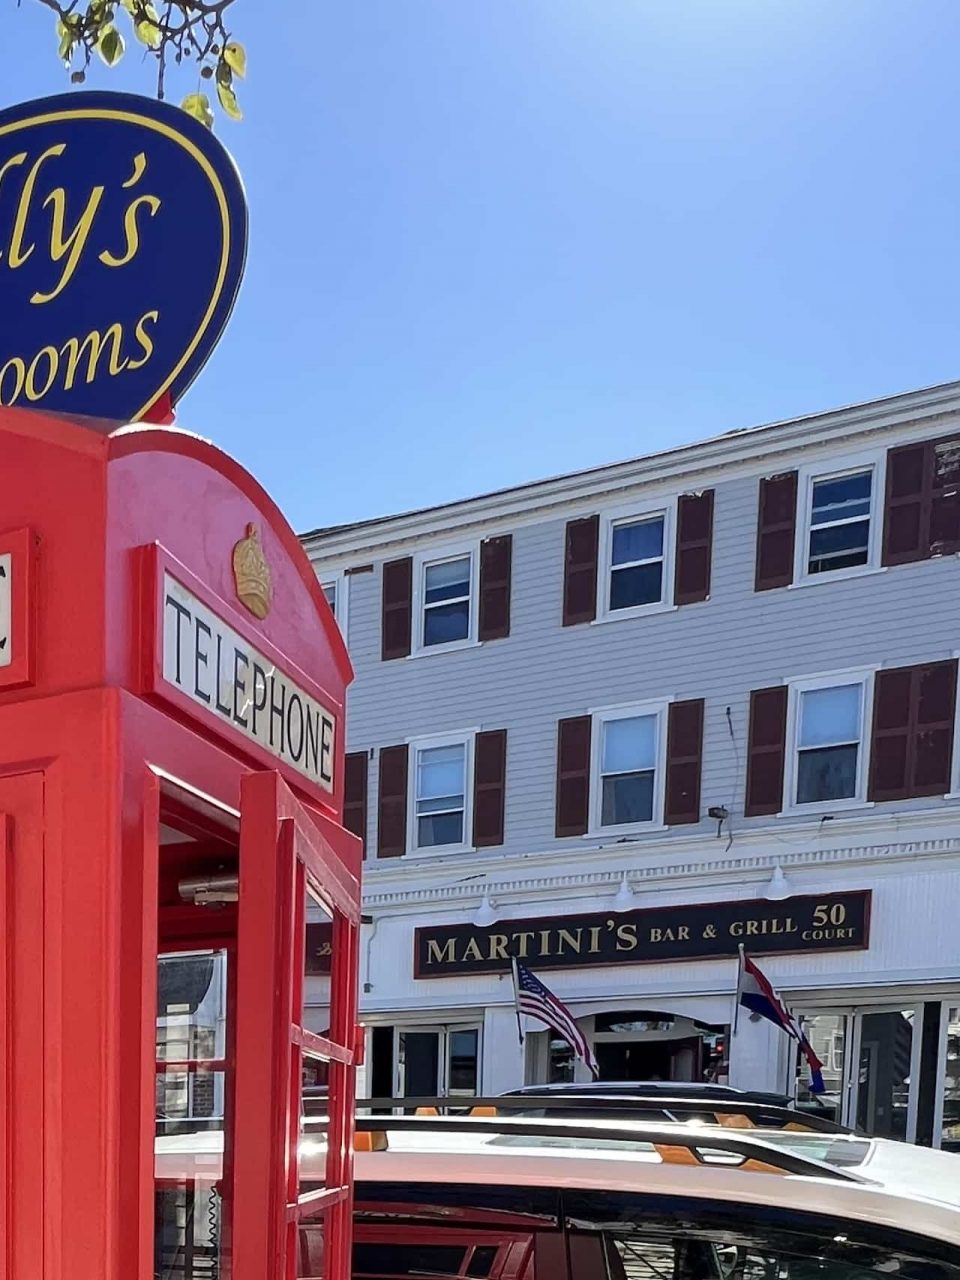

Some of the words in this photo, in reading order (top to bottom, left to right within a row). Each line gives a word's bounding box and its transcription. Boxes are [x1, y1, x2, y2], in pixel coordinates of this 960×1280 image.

[166, 594, 333, 783] TELEPHONE
[812, 903, 846, 926] 50
[426, 920, 639, 964] MARTINI'S
[650, 926, 690, 942] BAR
[702, 924, 717, 939] &
[729, 917, 798, 936] GRILL
[801, 927, 856, 941] COURT
